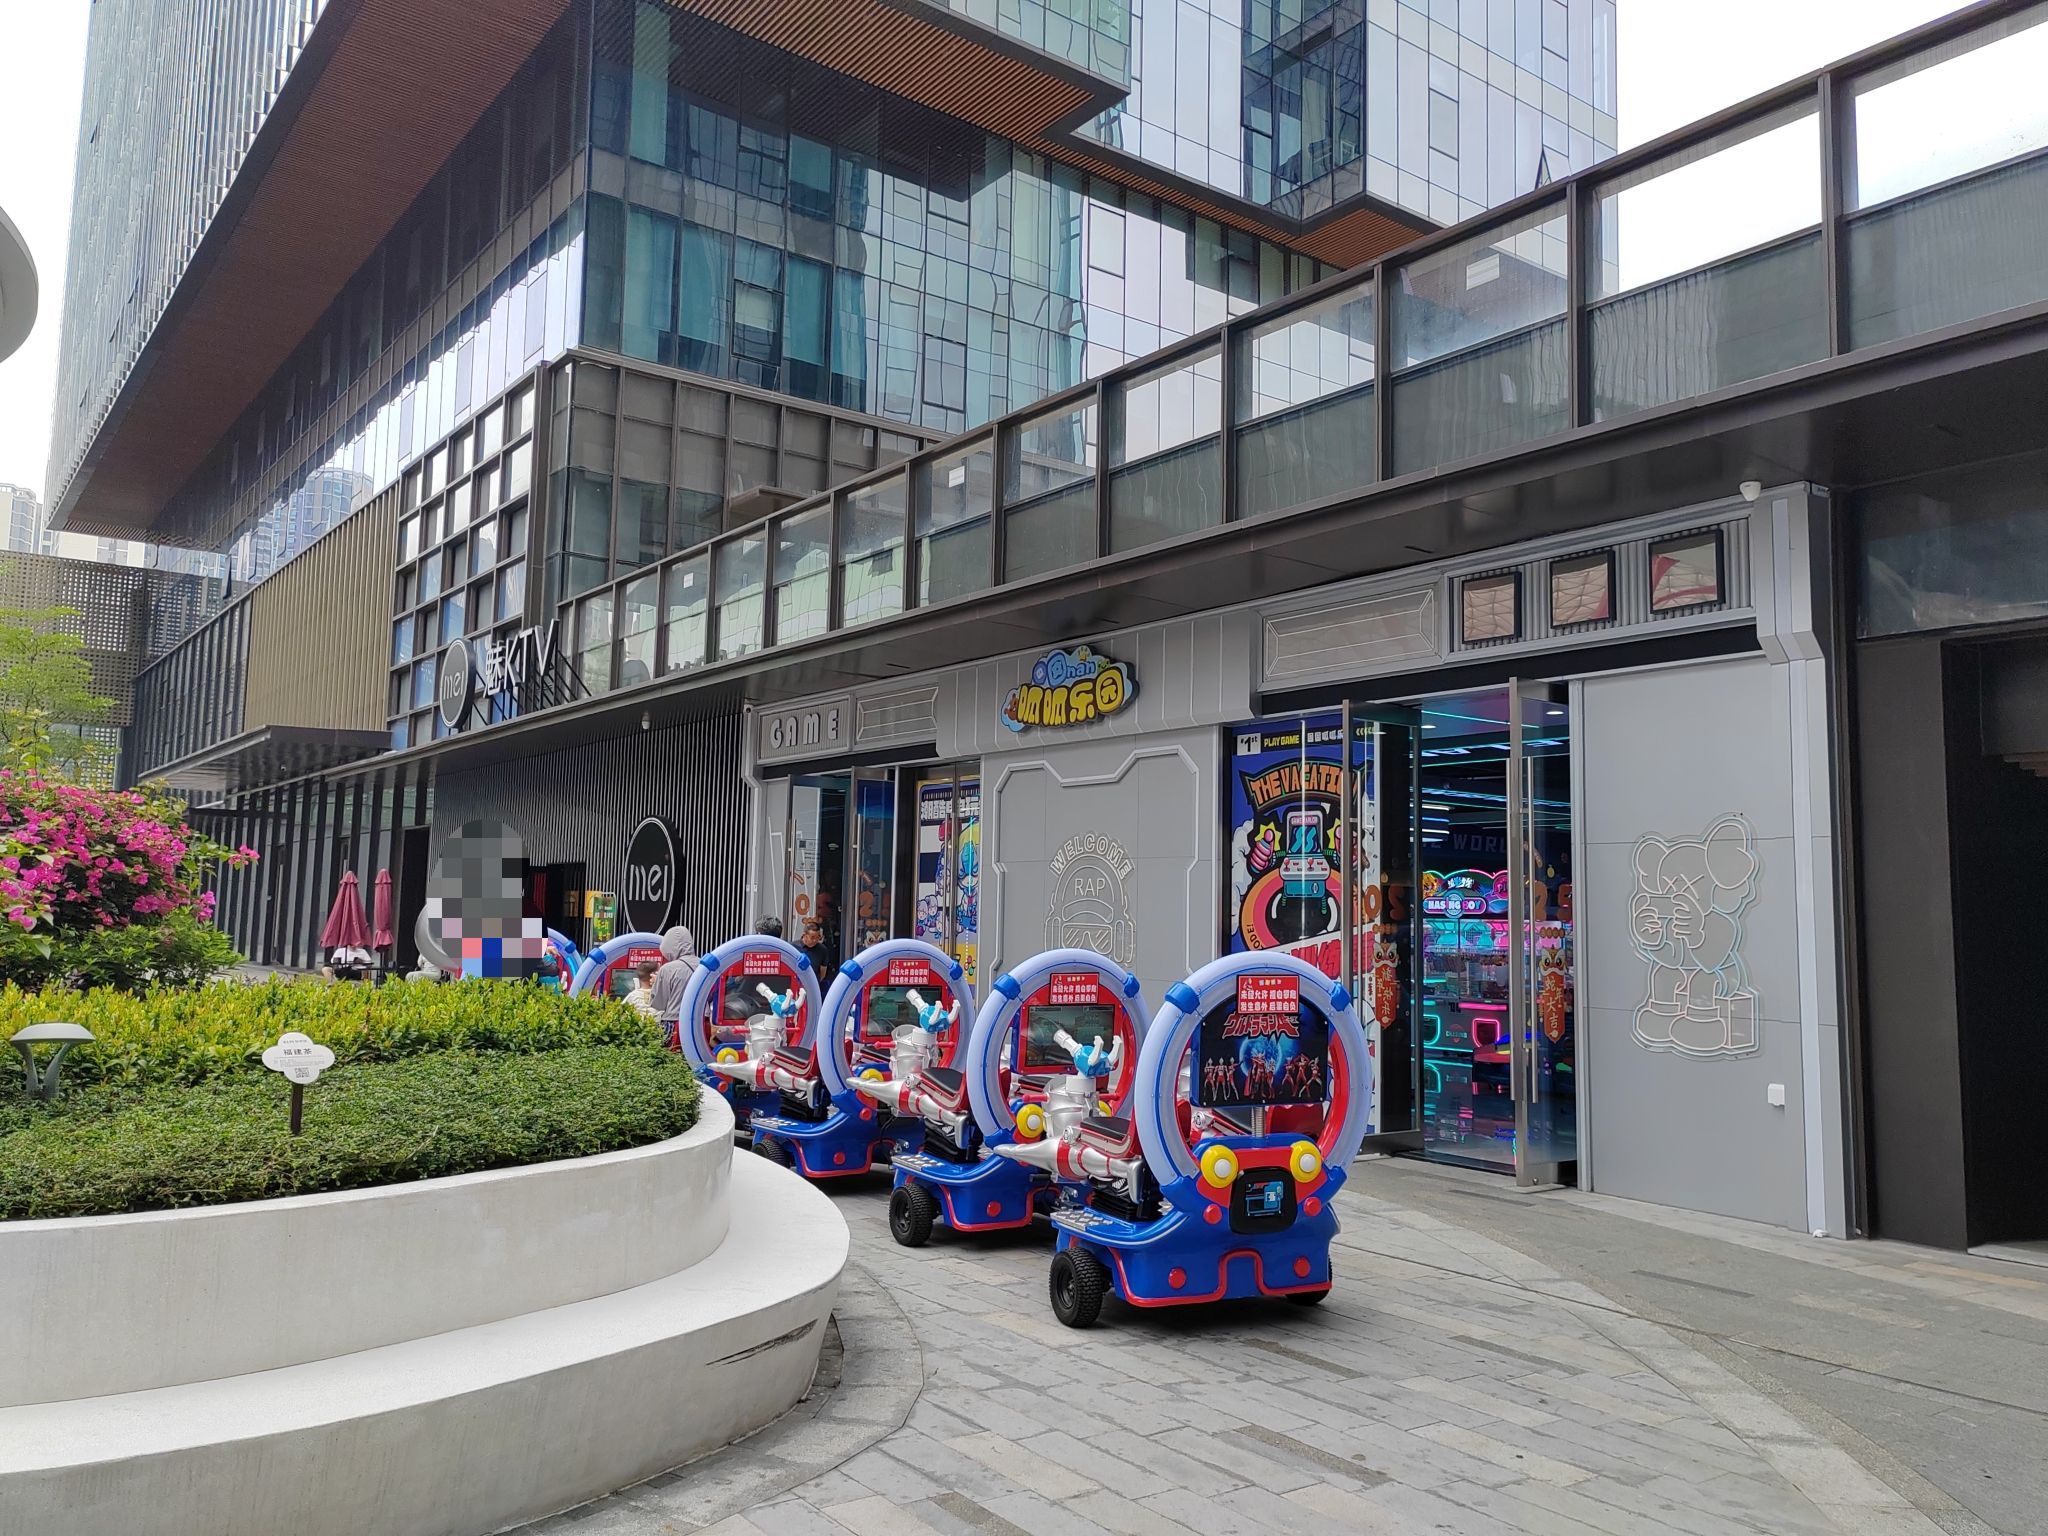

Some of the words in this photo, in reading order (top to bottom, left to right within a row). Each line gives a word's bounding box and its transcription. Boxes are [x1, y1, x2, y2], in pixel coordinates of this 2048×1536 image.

[443, 671, 465, 700] mei
[770, 709, 839, 749] GAME
[1264, 737, 1280, 747] PLAY
[1281, 735, 1300, 745] GAME
[1251, 777, 1282, 804] THE
[1049, 833, 1133, 879] WELCOME
[1453, 833, 1507, 853] WORL
[629, 863, 668, 902] mei
[1074, 878, 1106, 896] RAP
[1246, 923, 1264, 950] ODE!
